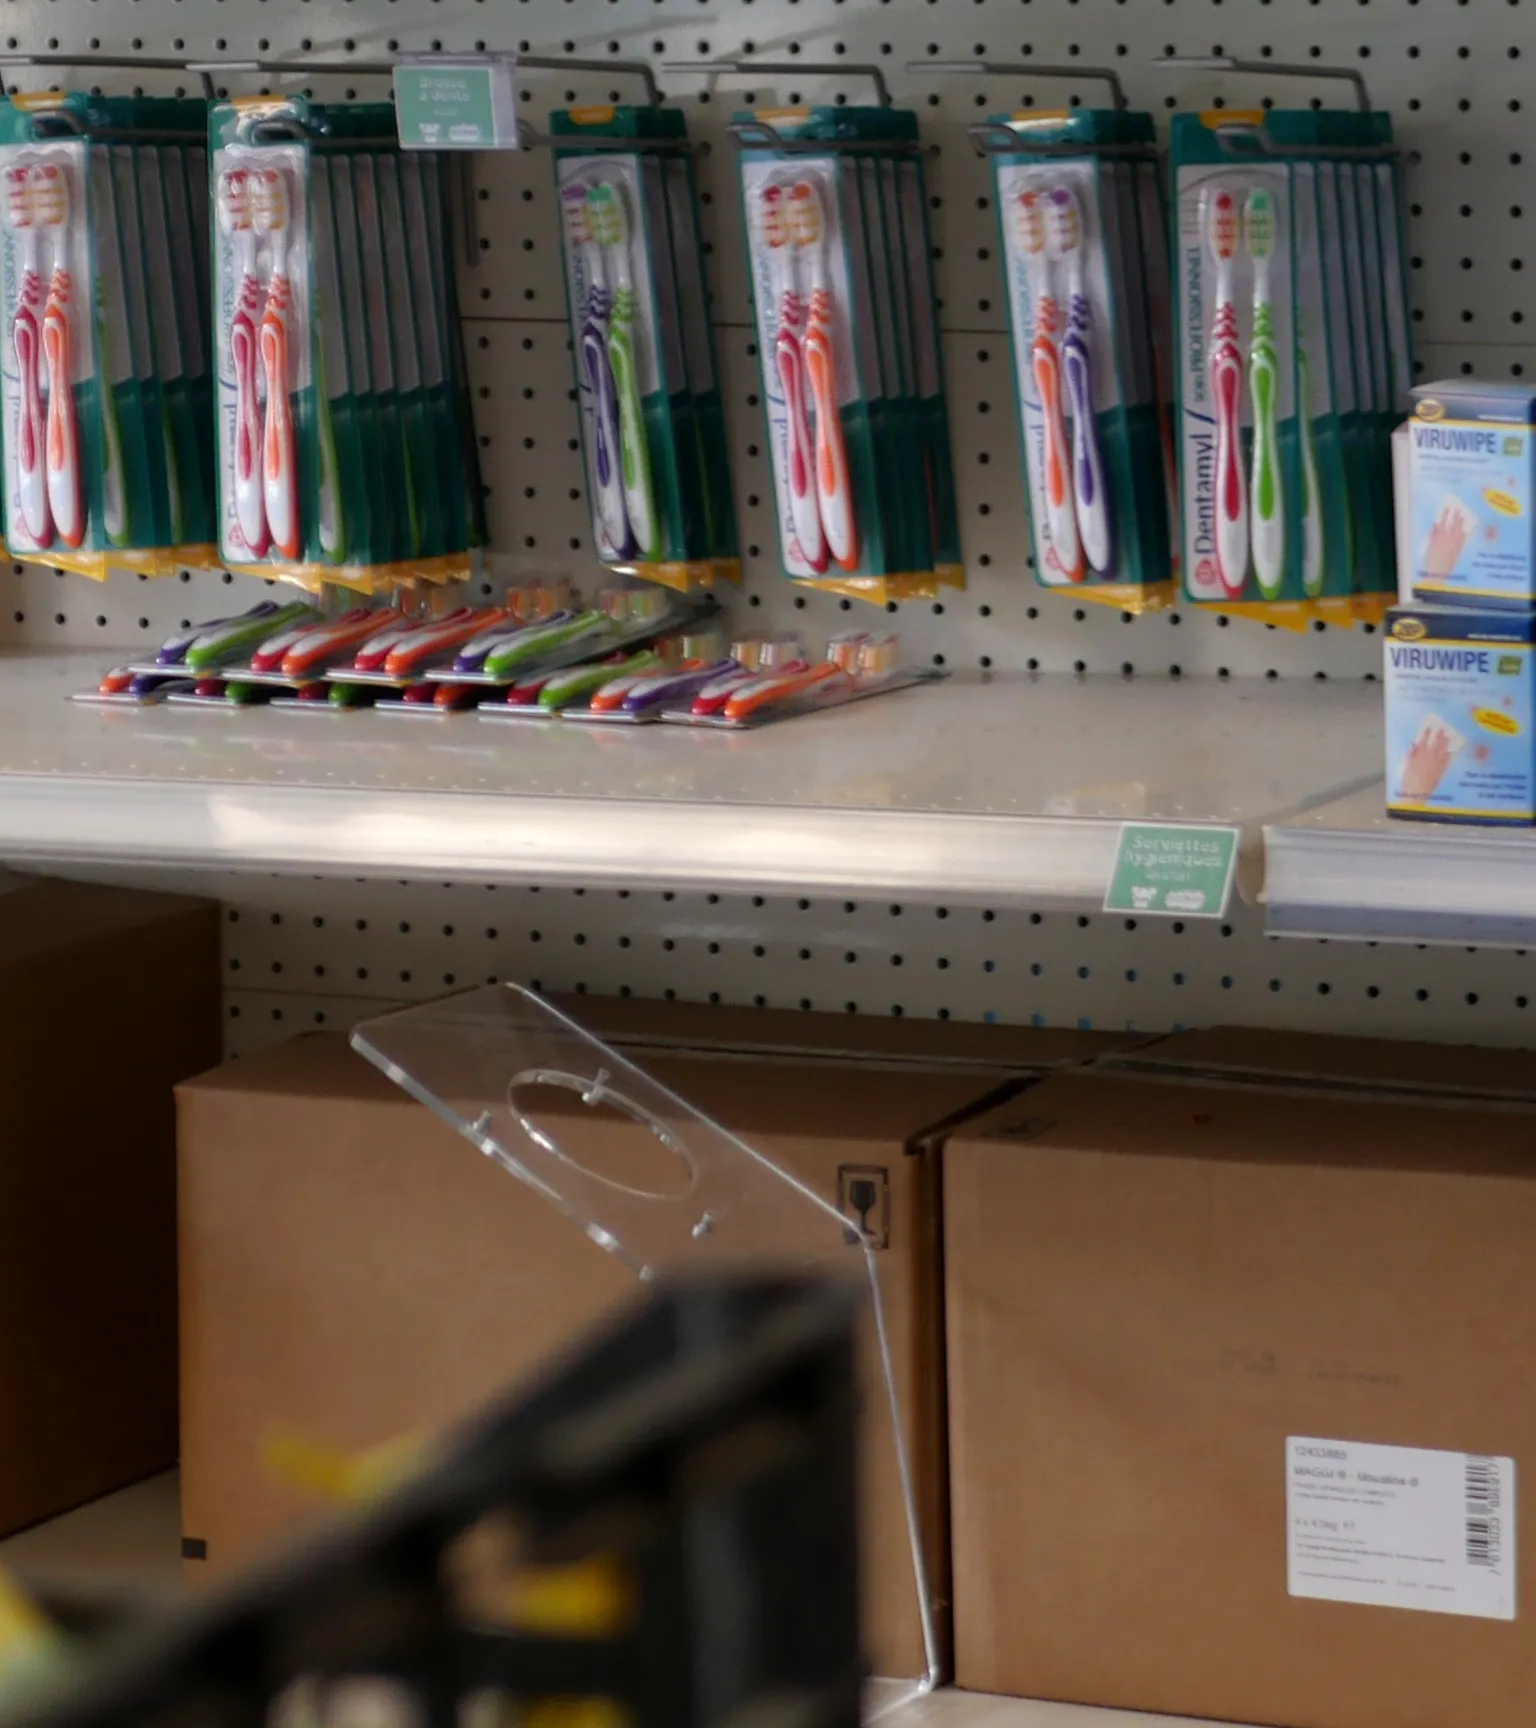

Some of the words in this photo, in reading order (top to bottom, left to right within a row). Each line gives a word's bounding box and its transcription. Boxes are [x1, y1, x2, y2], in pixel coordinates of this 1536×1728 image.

[1414, 428, 1497, 454] VIRUWIPE
[1191, 432, 1216, 556] Dentamyl
[1389, 647, 1490, 673] VIRUWIPE
